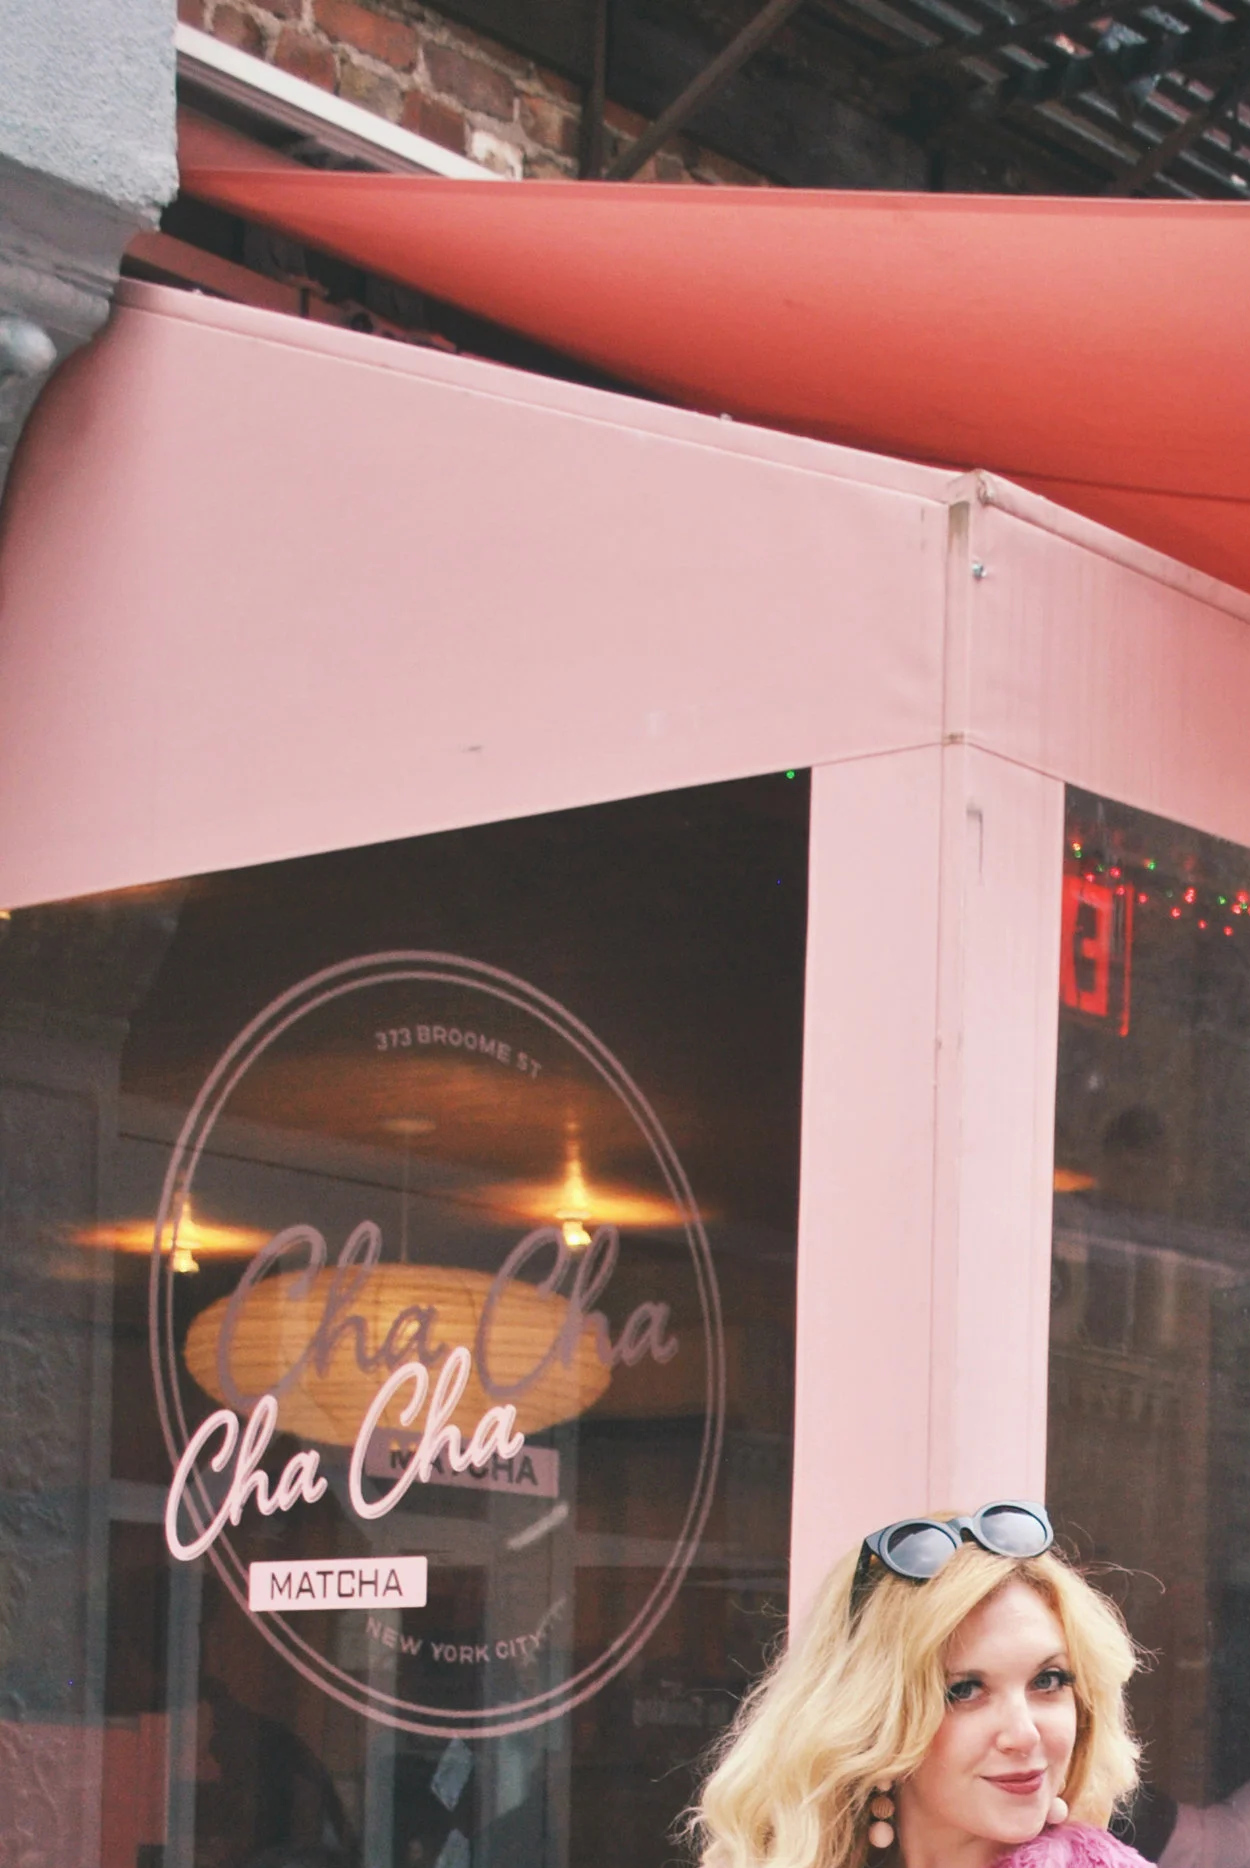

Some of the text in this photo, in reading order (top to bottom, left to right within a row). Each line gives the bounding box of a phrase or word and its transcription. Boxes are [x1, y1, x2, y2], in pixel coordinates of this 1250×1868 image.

[375, 1024, 542, 1079] 373 BROOME ST
[218, 1220, 679, 1408] Cha Cha
[165, 1346, 525, 1562] Cha Cha
[270, 1569, 403, 1600] MATCHA
[365, 1616, 542, 1665] NEW YORK CITY
